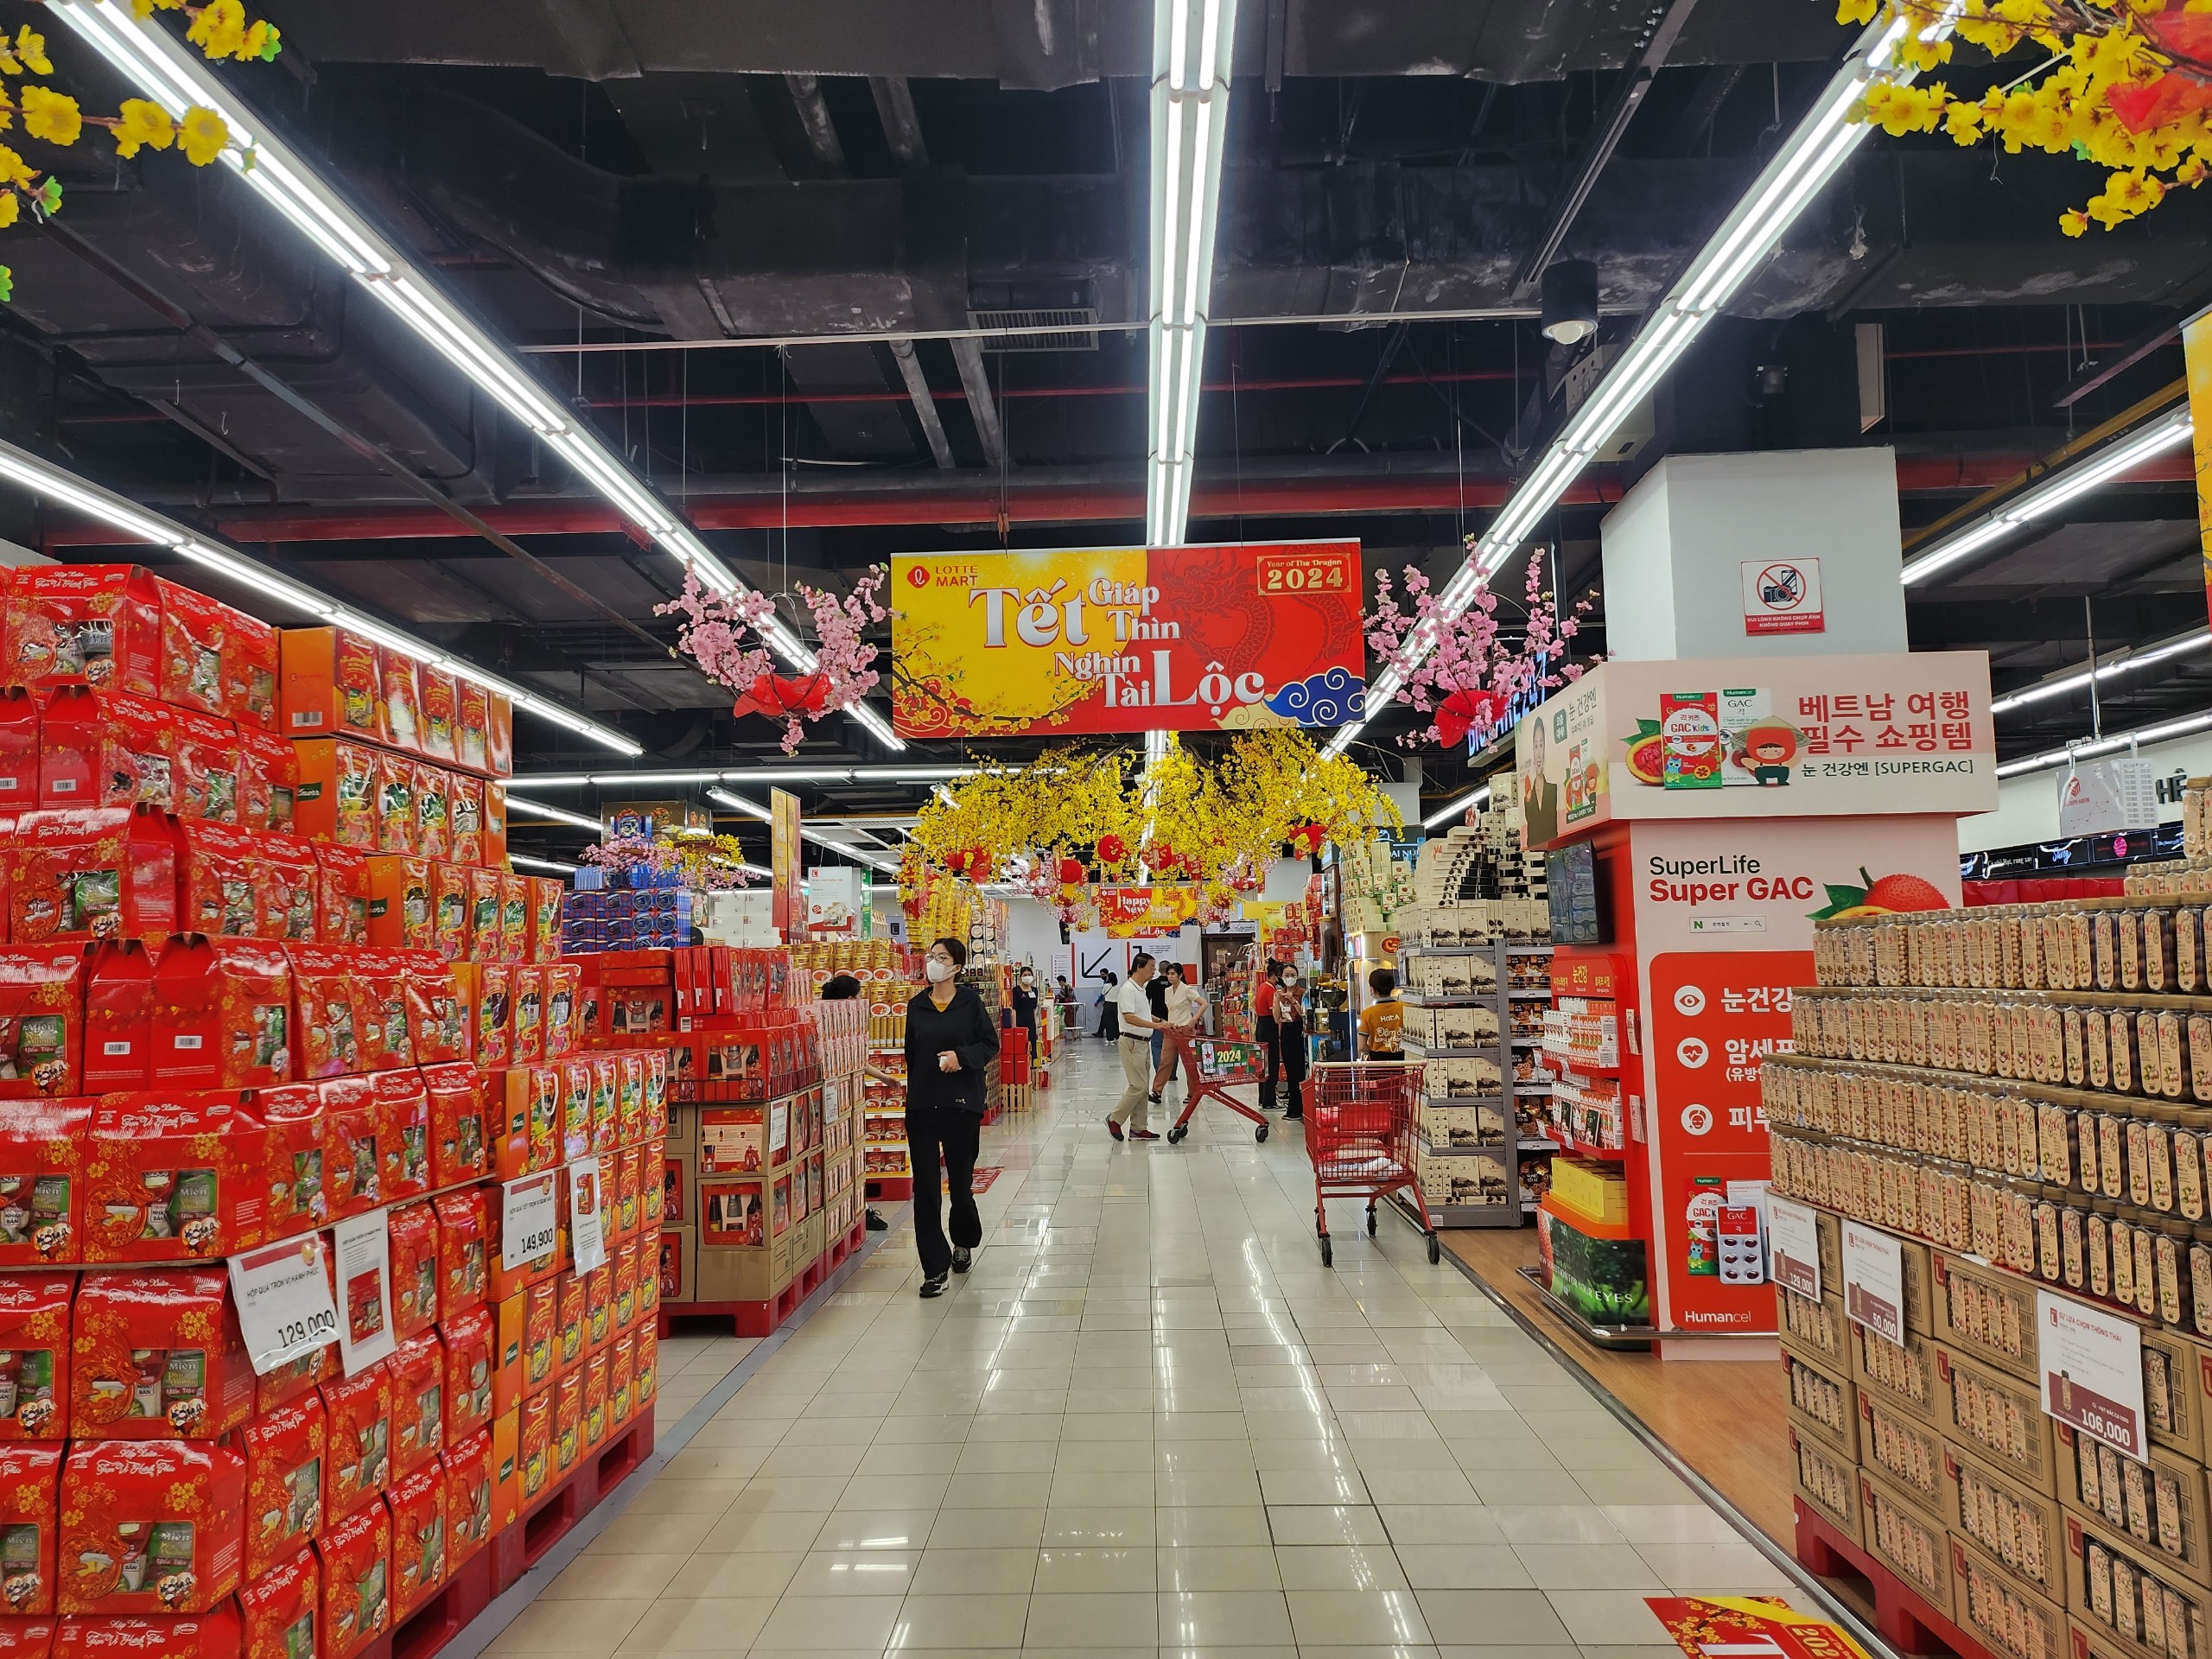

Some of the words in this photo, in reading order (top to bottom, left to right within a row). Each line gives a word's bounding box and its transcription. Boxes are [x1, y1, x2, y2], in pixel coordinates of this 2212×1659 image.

[936, 565, 978, 575] LOTTE
[936, 575, 978, 588] MART
[1267, 567, 1343, 589] 2024
[1089, 578, 1160, 616] Giáp
[969, 577, 1090, 648] Tết
[1107, 610, 1180, 642] Thìn
[1054, 651, 1141, 681] Nghìn
[1096, 671, 1151, 709] Tài
[1152, 650, 1265, 716] Lộc
[1727, 699, 1752, 708] GAC
[1798, 693, 1896, 723] 베트남
[1907, 691, 1970, 721] 여행
[1670, 723, 1691, 733] GAC
[1800, 724, 1865, 754] 필수
[1875, 721, 1973, 752] 쇼핑템
[1801, 763, 1817, 778] 눈
[1822, 761, 1869, 777] 건강엔
[1875, 760, 1974, 776] [SUPERGAC]
[1649, 855, 1761, 879] SuperLife
[1121, 896, 1151, 906] Happy
[1649, 879, 1738, 906] Super
[1746, 877, 1815, 900] GAC
[1123, 905, 1147, 914] New
[1217, 1050, 1241, 1063] 2024
[1694, 1208, 1711, 1217] GAC
[522, 1227, 553, 1254] 149,900
[1789, 1272, 1814, 1294] 129,000
[1595, 1290, 1633, 1303] EYES
[277, 1309, 335, 1349] 129,000
[1685, 1310, 1751, 1324] Humancel
[1872, 1312, 1897, 1338] 50,000
[2081, 1408, 2131, 1447] 106,000
[1791, 1627, 1840, 1659] 202
